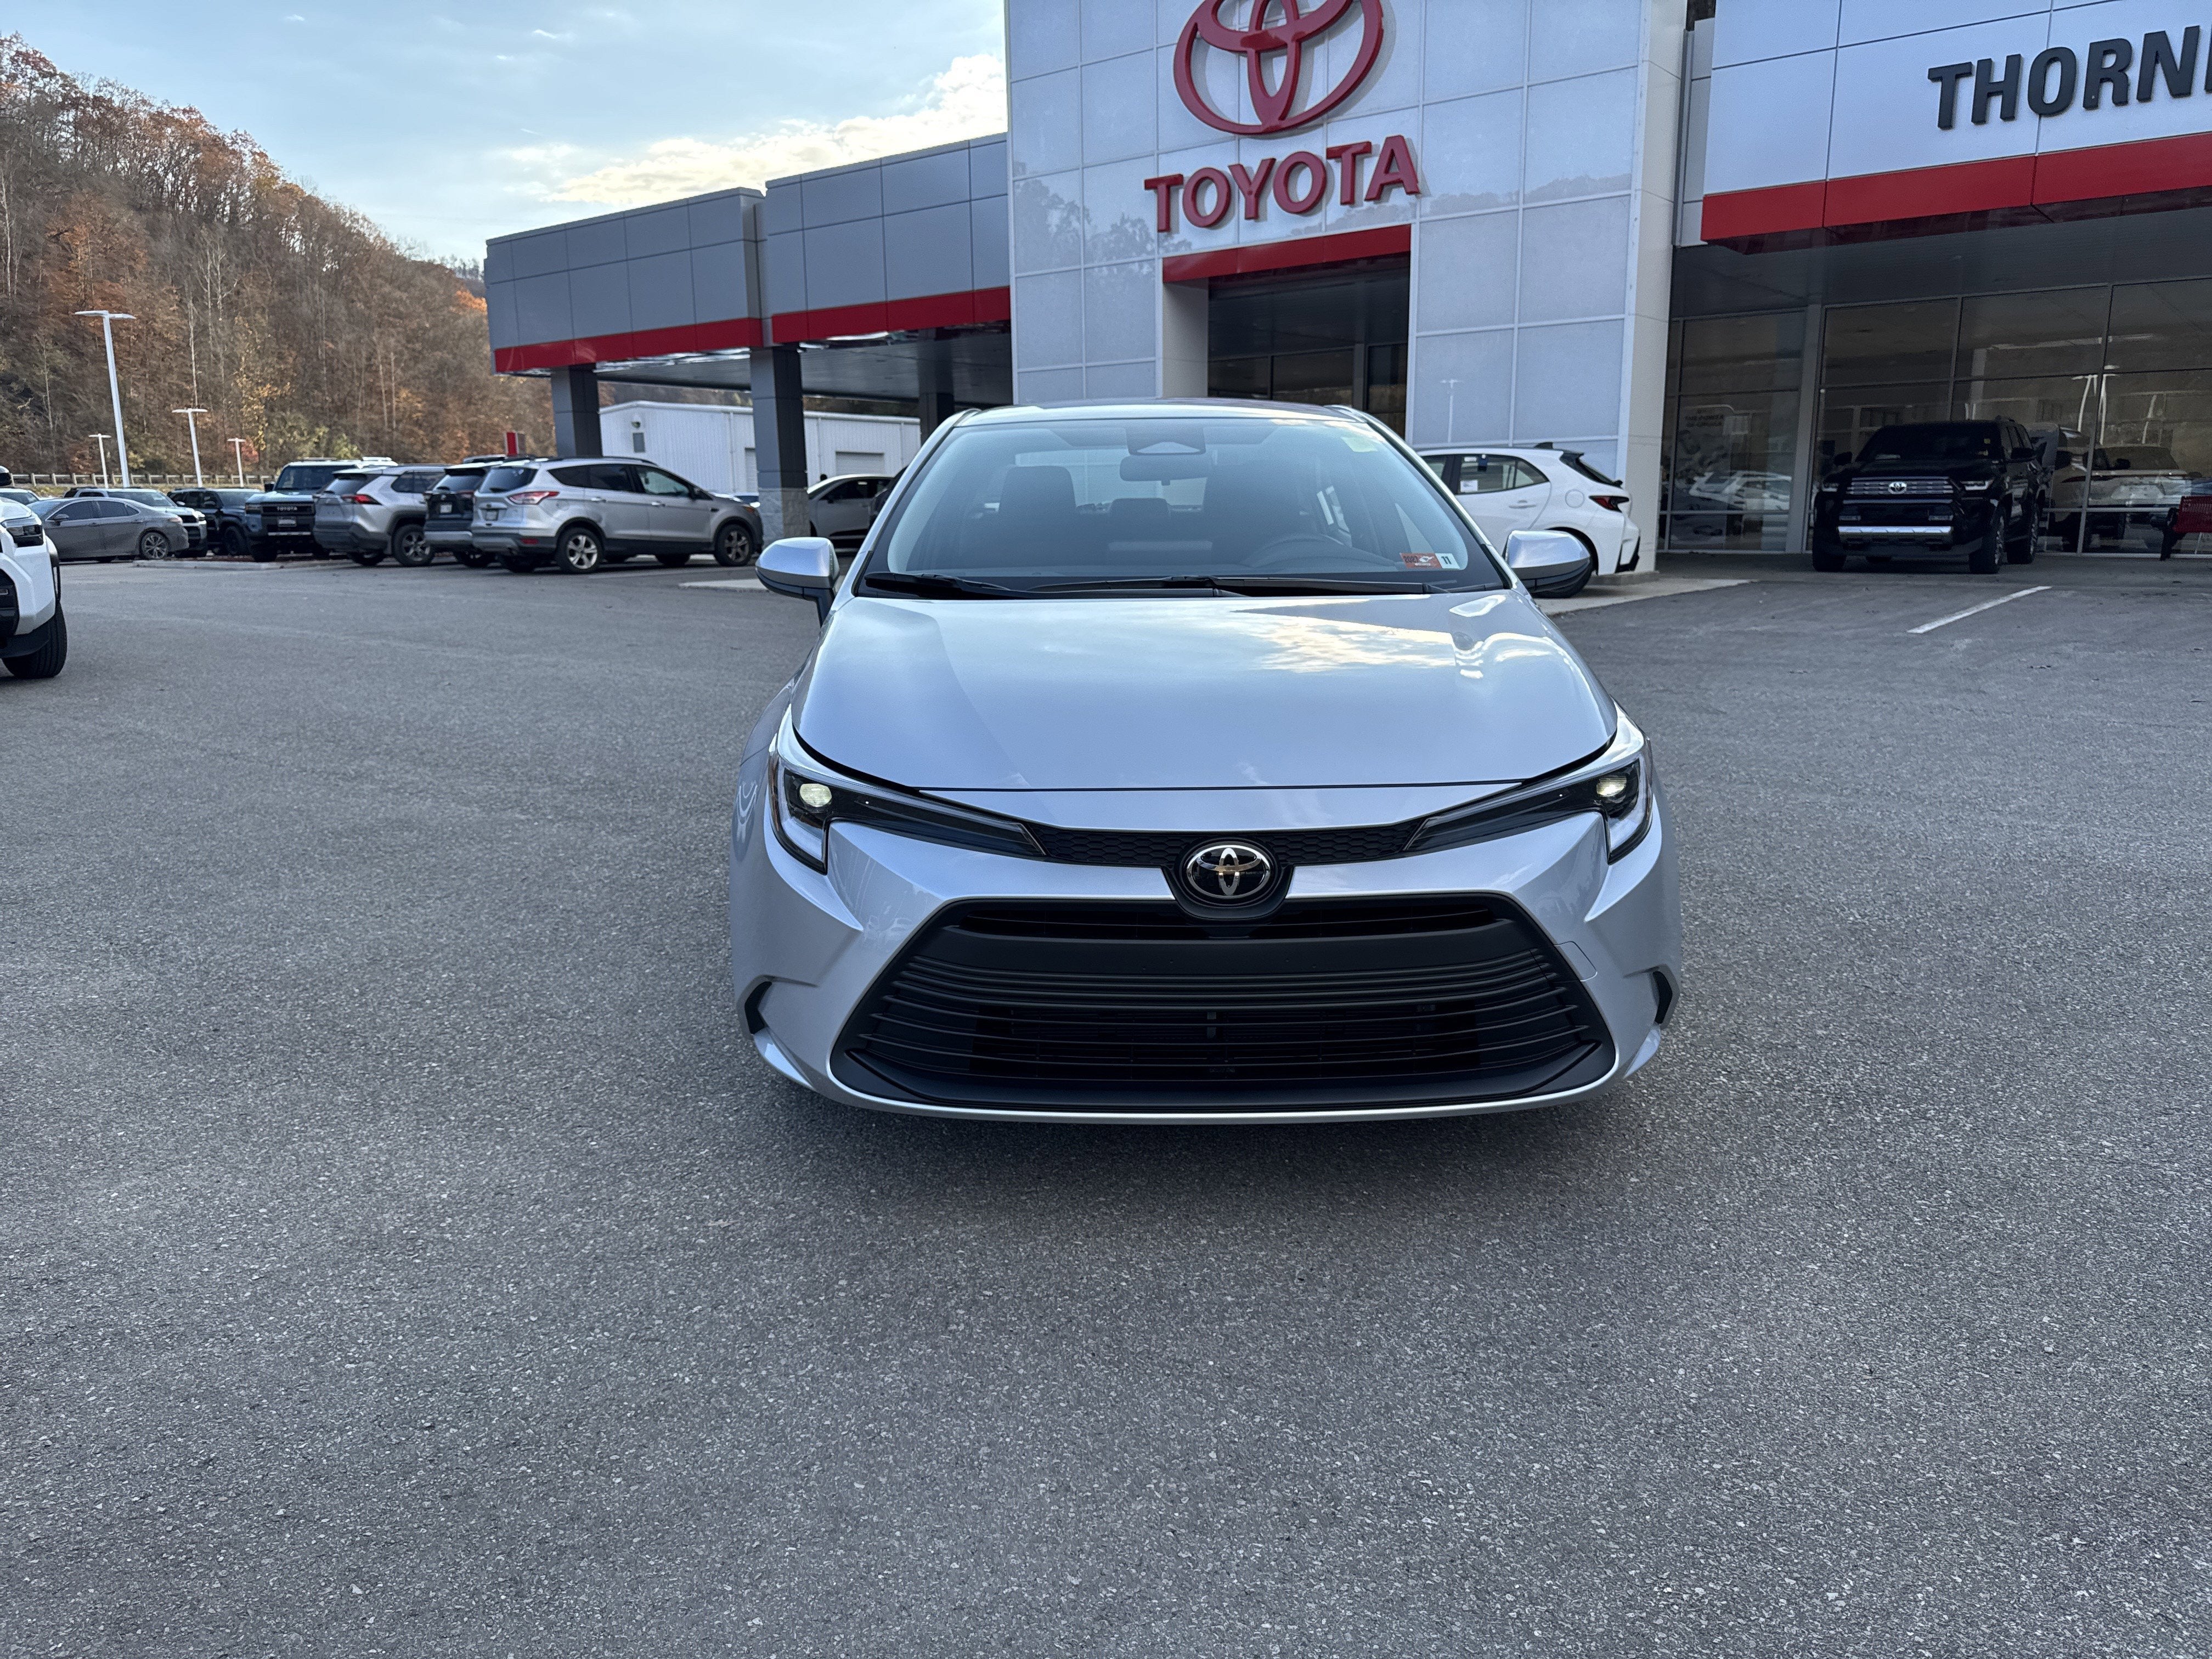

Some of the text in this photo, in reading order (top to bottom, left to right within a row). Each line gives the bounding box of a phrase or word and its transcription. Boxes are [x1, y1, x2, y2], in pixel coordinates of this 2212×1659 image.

[1928, 24, 2212, 130] THORN
[1144, 135, 1421, 233] TOYOTA
[1441, 556, 1452, 565] 11
